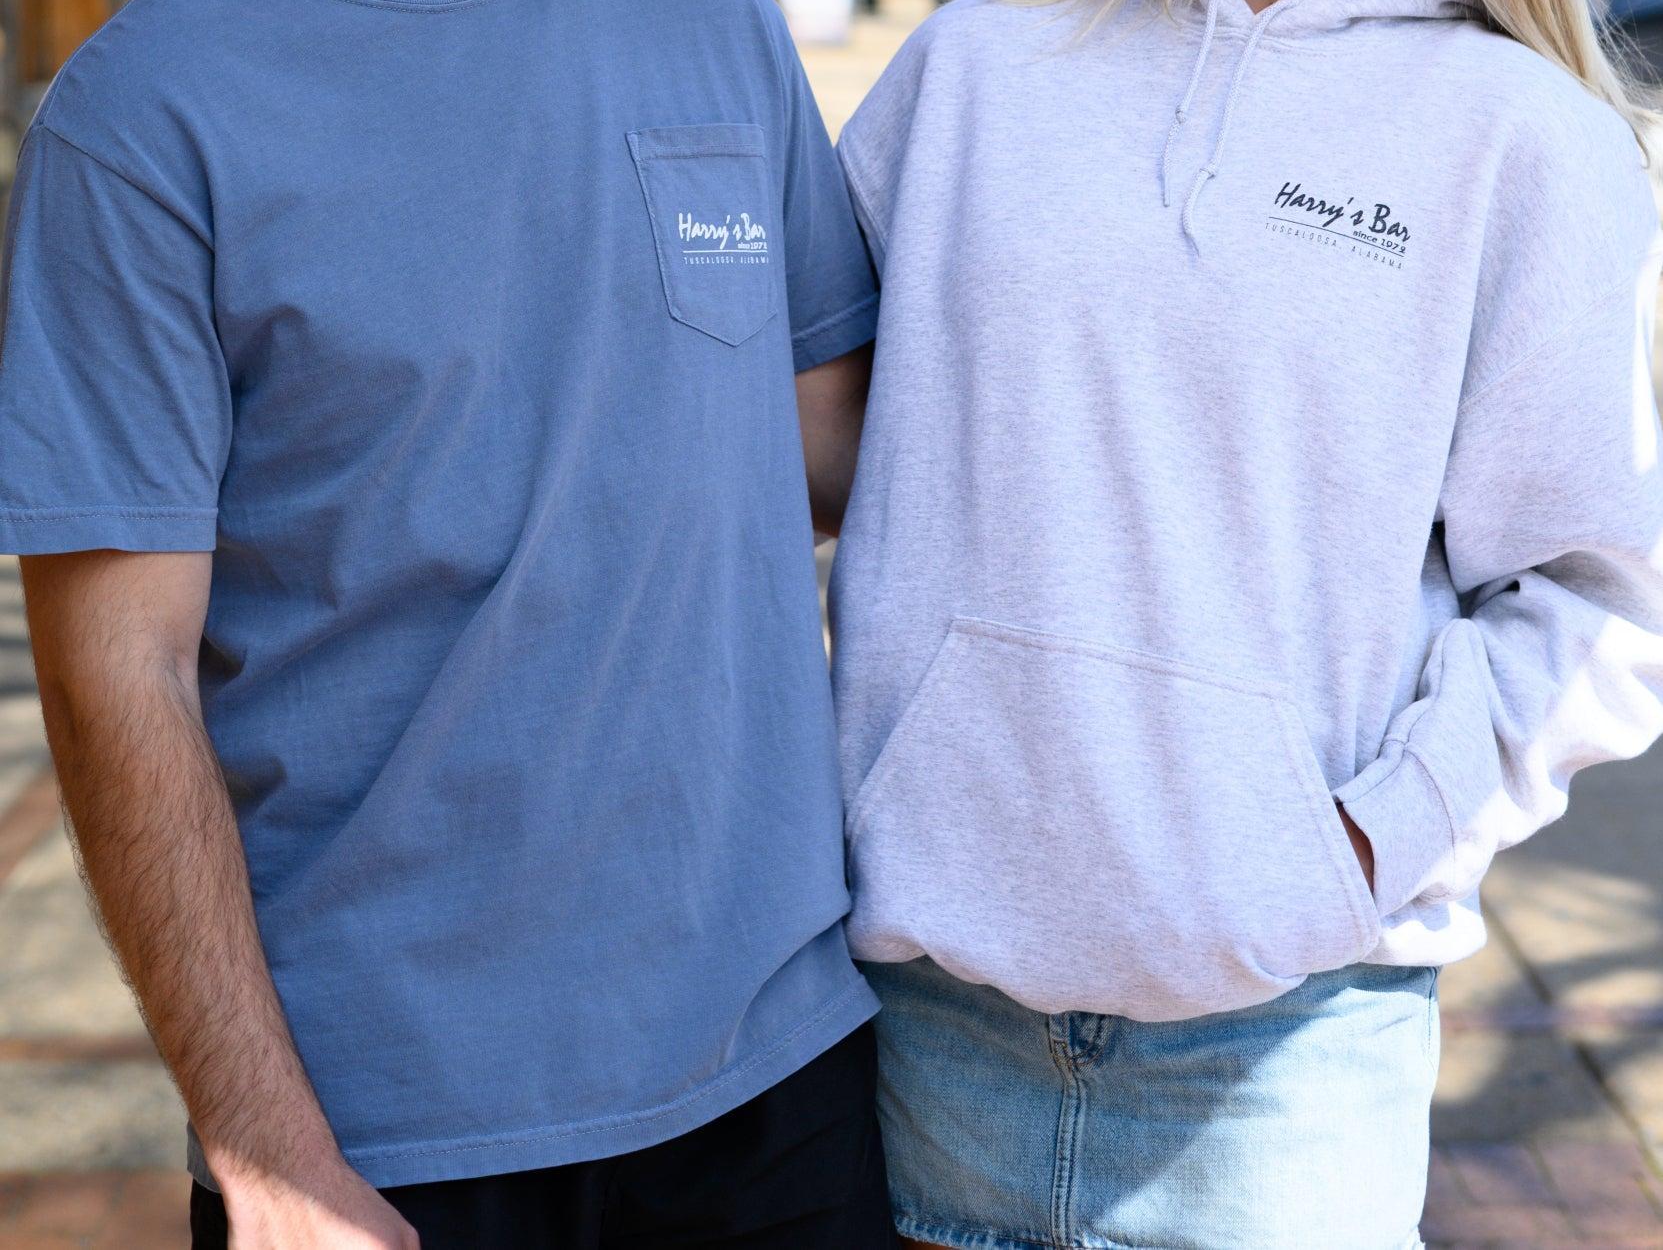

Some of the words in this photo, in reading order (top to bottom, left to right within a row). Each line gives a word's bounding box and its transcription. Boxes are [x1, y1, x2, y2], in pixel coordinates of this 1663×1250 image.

[678, 212, 742, 250] Harry's
[740, 212, 766, 241] Bar
[1274, 182, 1364, 227] Harry's
[1368, 203, 1411, 242] Bar
[1353, 230, 1378, 243] since
